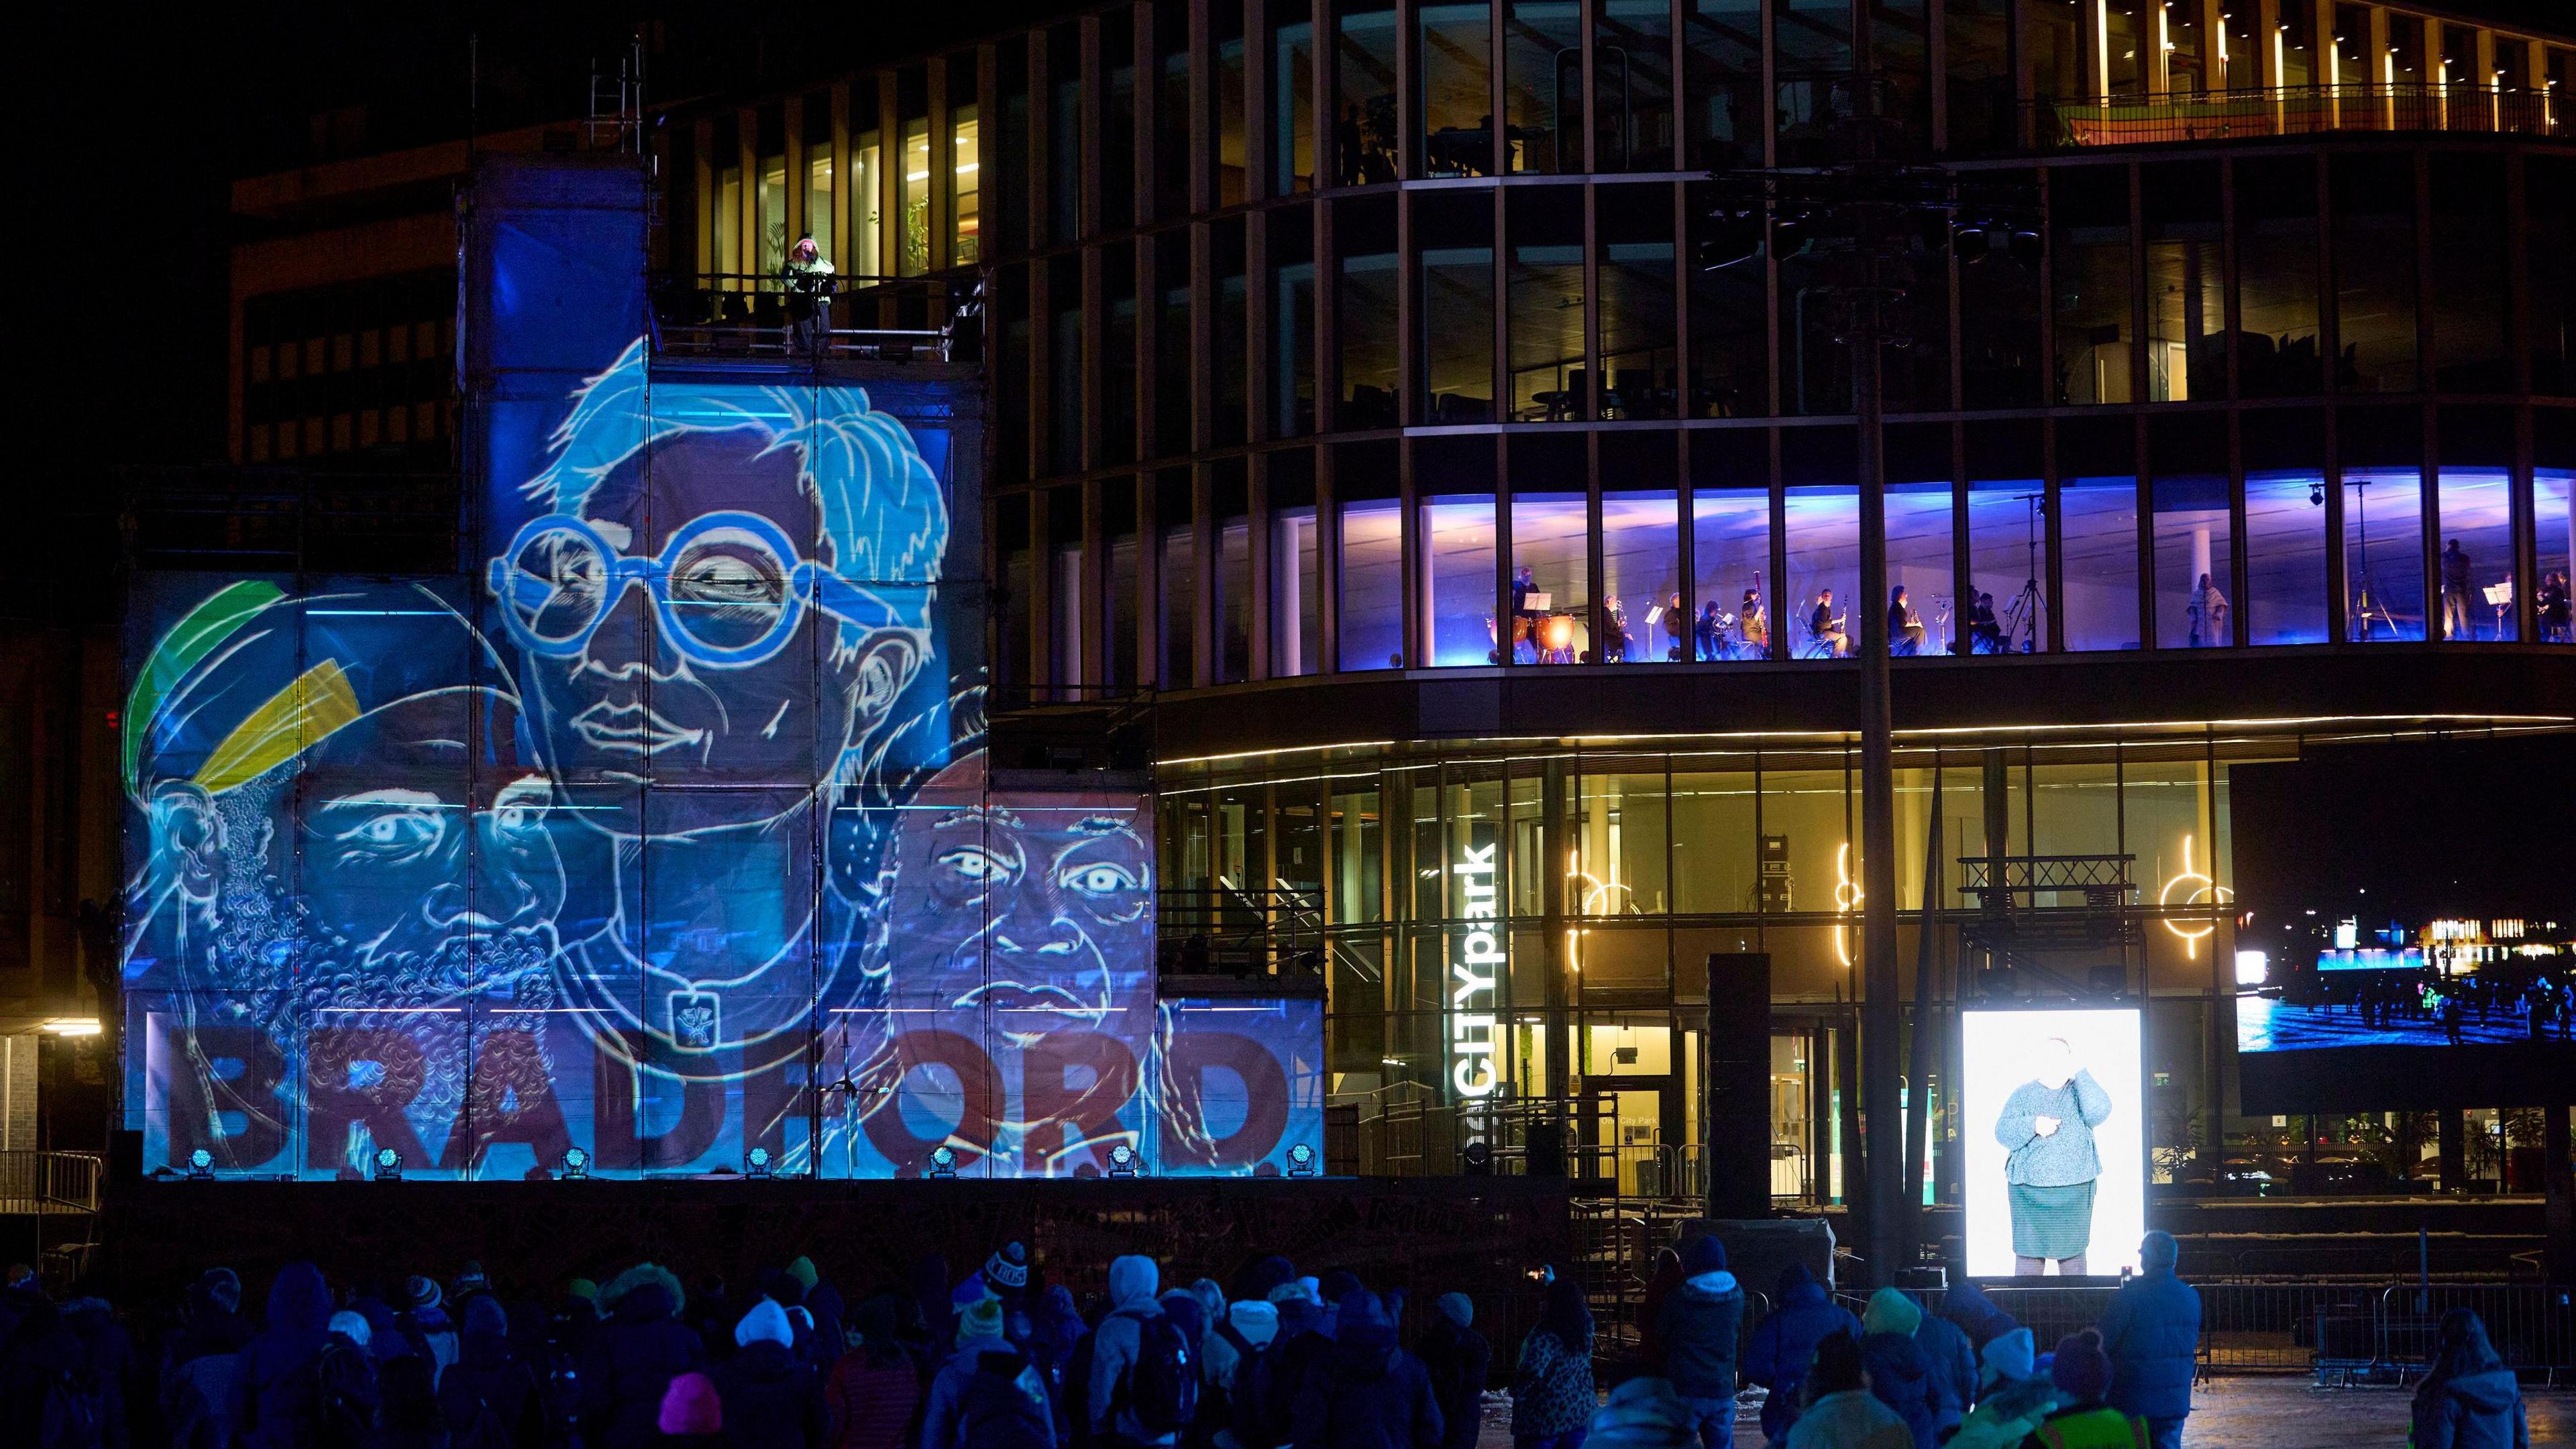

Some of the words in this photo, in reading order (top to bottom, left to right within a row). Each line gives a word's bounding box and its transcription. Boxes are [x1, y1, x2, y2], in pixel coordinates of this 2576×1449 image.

[170, 1028, 1288, 1170] BRADFORD
[1601, 1117, 1617, 1125] On
[1620, 1116, 1635, 1126] City
[1638, 1116, 1658, 1125] Park
